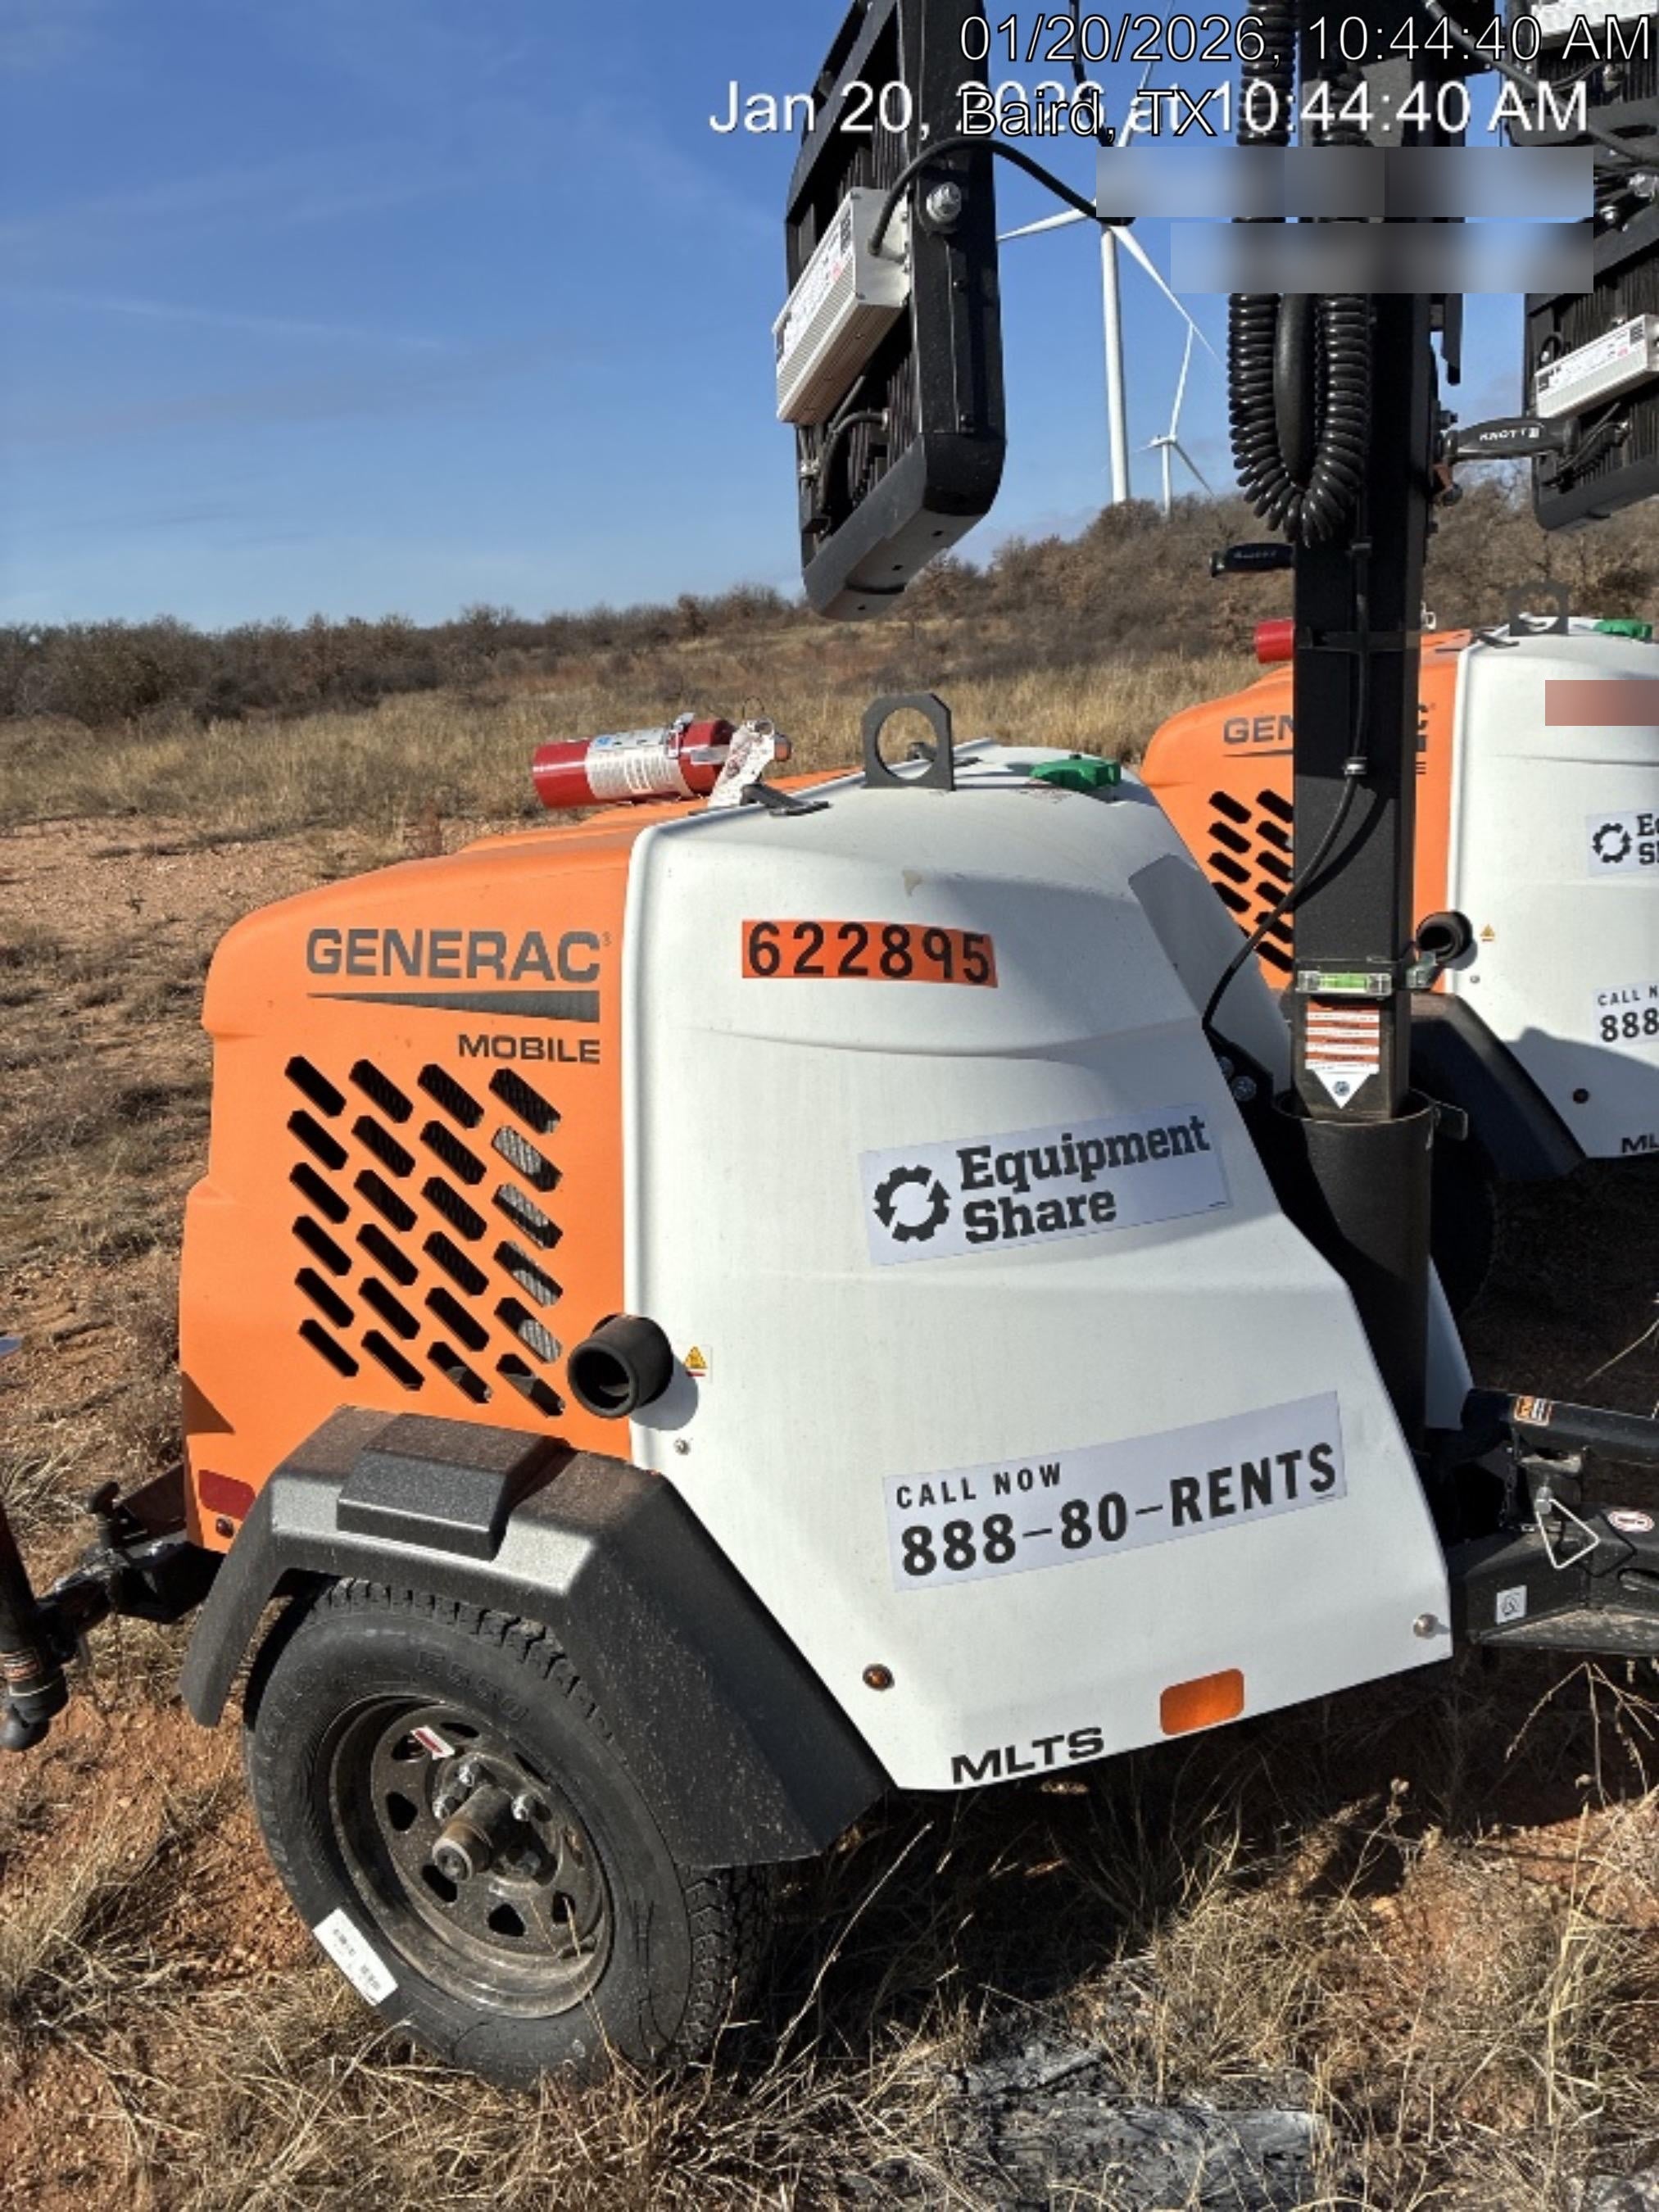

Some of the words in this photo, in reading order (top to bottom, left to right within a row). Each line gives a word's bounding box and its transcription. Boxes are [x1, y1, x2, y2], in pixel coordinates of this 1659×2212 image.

[1636, 812, 1659, 836] E
[1639, 841, 1659, 865] S
[306, 928, 601, 983] GENERAC
[749, 922, 989, 983] 622895
[1598, 989, 1641, 1007] CALL
[458, 1033, 601, 1064] MOBILE
[956, 1115, 1211, 1193] Equipment
[963, 1190, 1117, 1244] Share
[896, 1477, 977, 1509] CALL
[994, 1462, 1062, 1495] NOW
[901, 1442, 1336, 1576] 888-80-RENTS
[950, 1727, 1104, 1784] MLTS
